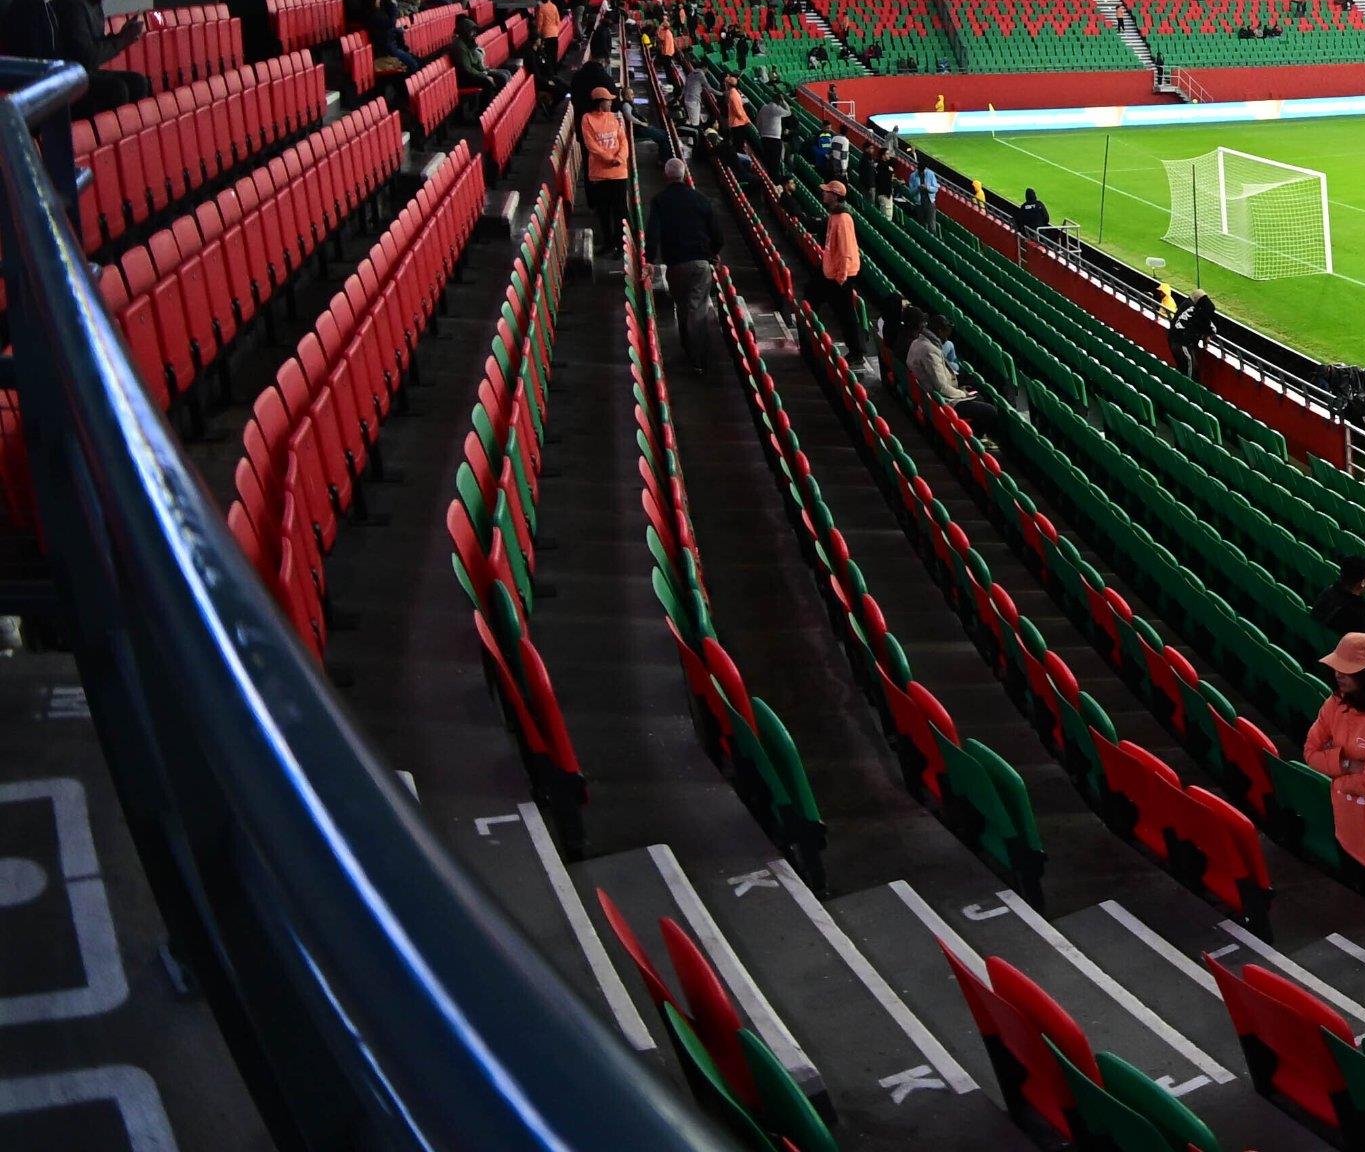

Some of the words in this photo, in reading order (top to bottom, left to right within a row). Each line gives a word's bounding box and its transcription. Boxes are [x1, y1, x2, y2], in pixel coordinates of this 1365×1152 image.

[473, 814, 521, 836] L
[726, 869, 780, 898] K
[962, 903, 1010, 921] J
[878, 1064, 946, 1105] K
